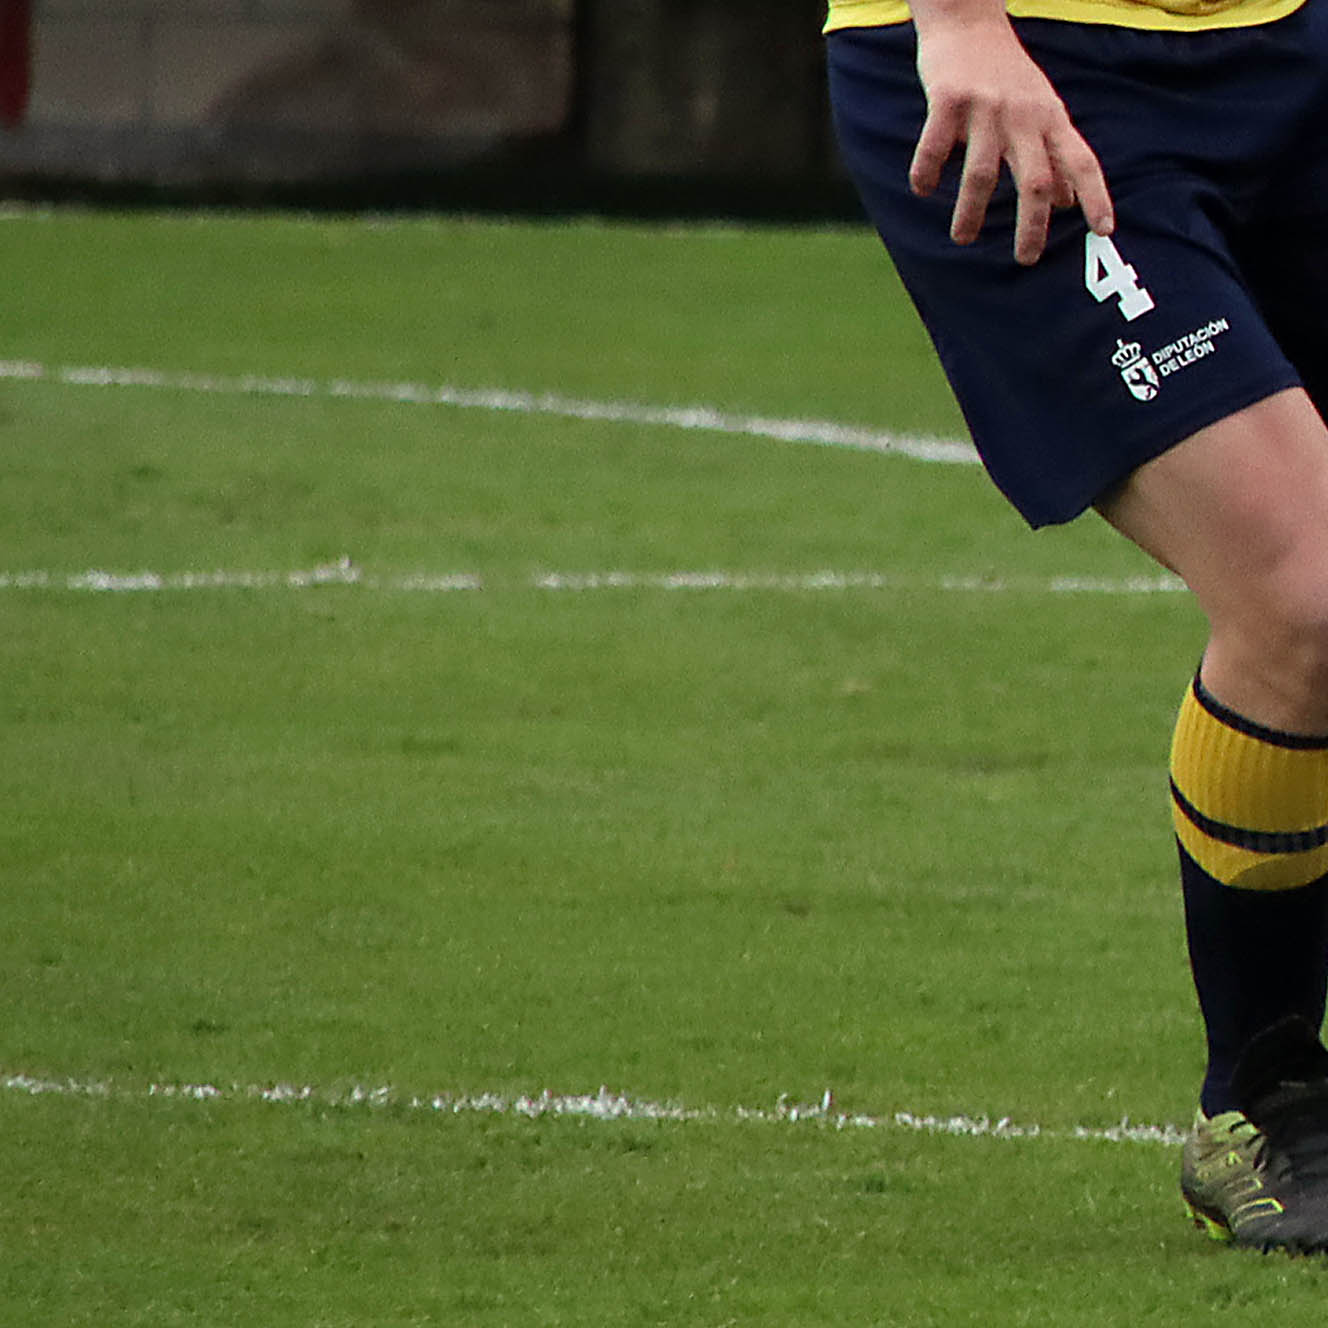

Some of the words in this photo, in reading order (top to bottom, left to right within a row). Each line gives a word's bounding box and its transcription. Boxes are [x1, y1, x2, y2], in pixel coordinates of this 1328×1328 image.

[1085, 230, 1155, 322] 4
[1151, 318, 1229, 365] DIPUTACIÓN
[1159, 358, 1180, 377] DE
[1176, 339, 1215, 367] LEÓN
